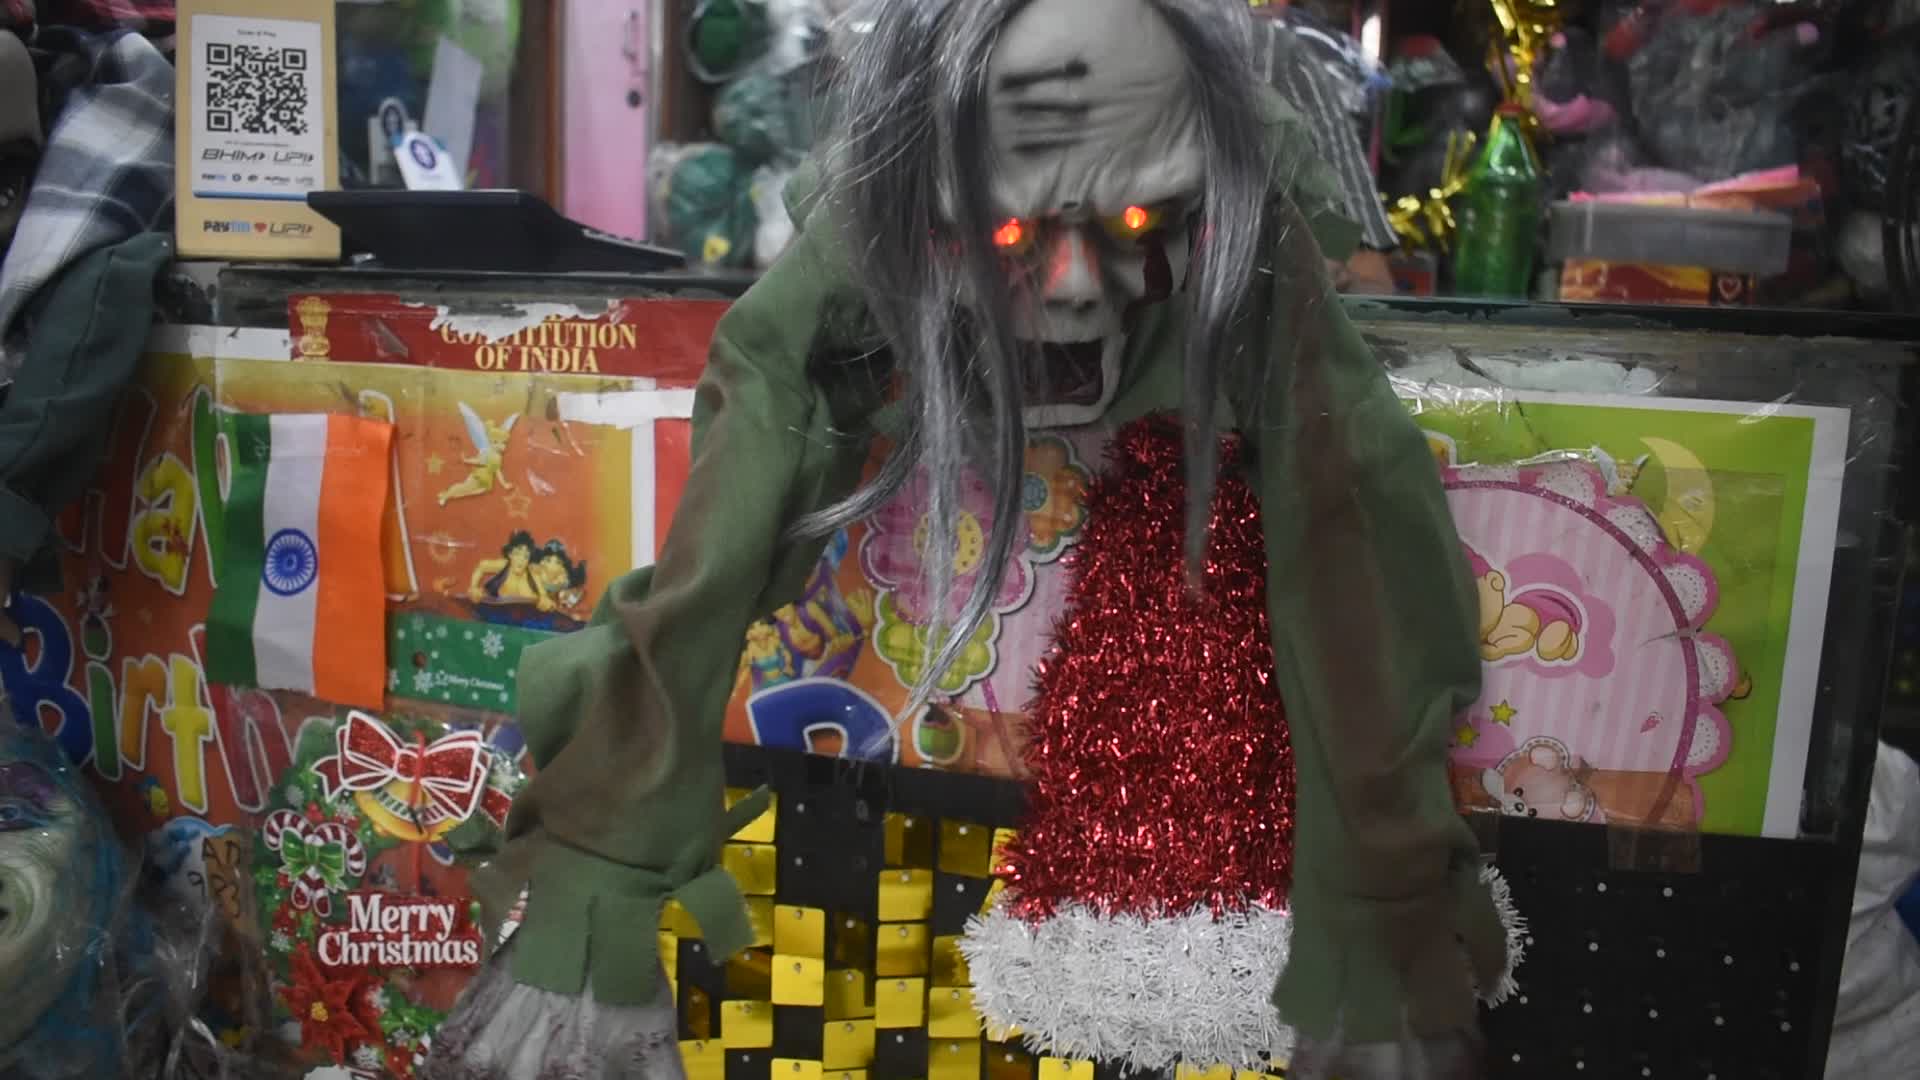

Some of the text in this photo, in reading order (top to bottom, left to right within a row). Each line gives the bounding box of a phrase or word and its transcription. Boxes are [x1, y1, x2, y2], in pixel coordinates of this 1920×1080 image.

[202, 148, 313, 163] BHIM UPI
[474, 345, 601, 373] OF INDIA
[347, 893, 456, 942] Merry
[317, 930, 480, 966] Christmas
